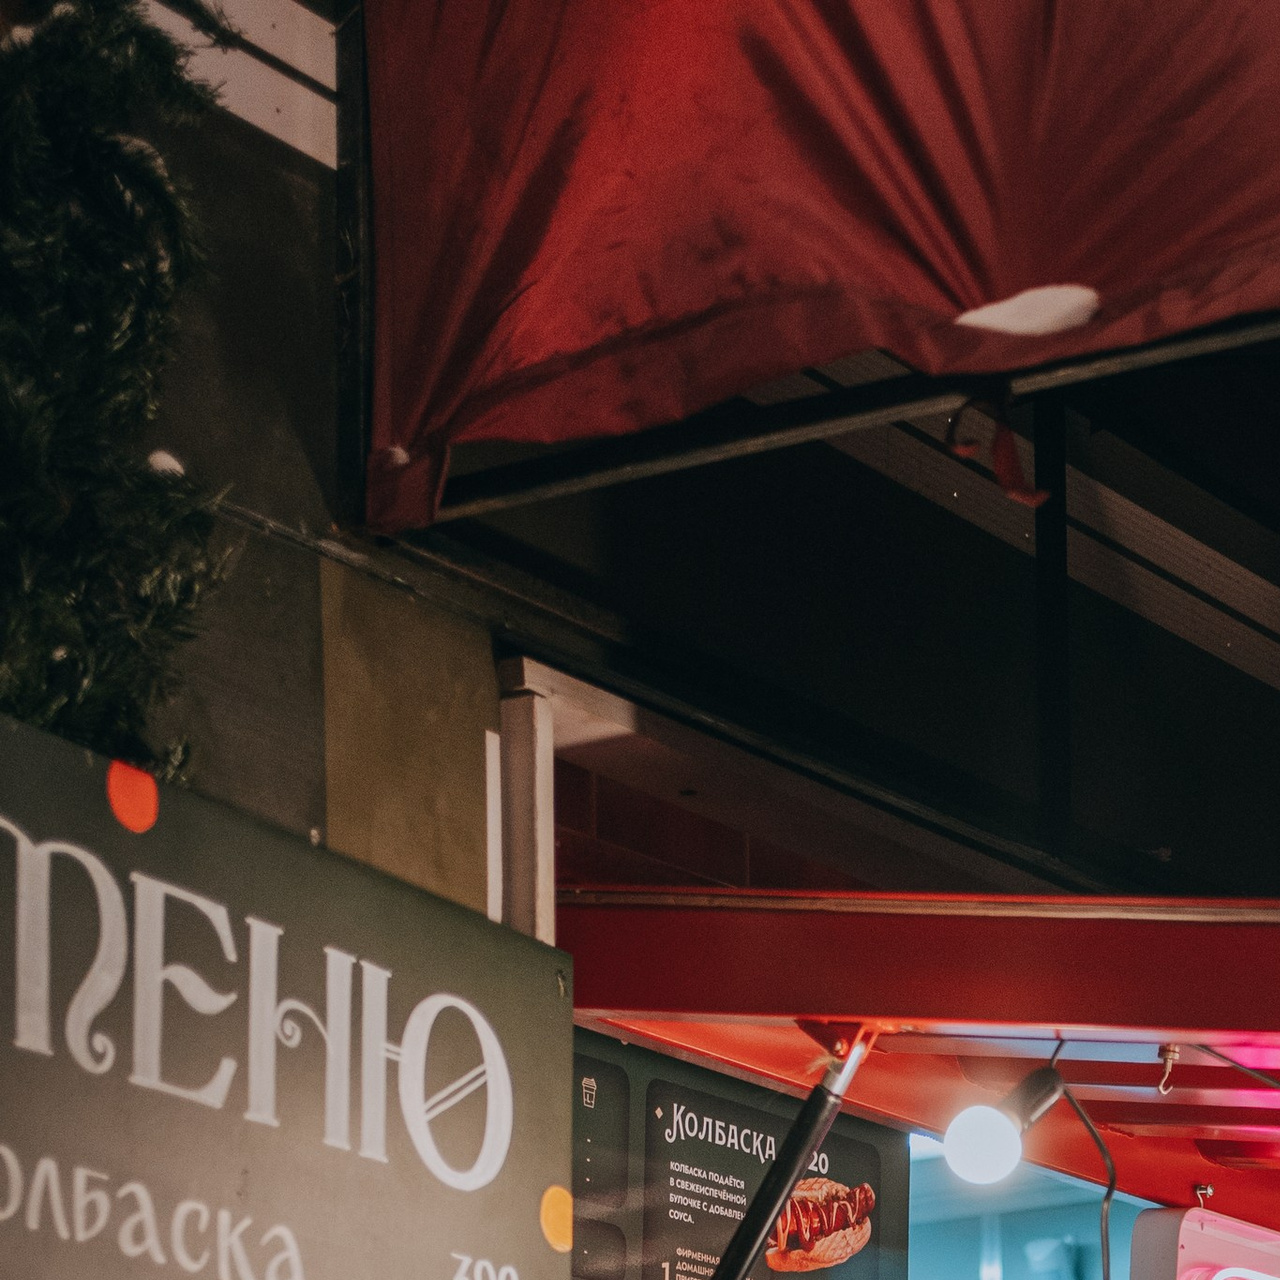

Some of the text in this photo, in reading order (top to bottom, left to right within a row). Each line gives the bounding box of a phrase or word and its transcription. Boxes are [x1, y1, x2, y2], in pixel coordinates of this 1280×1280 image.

[665, 1102, 829, 1175] КОЛБАСКА 20
[670, 1161, 745, 1190] КОЛБАСКА ПОДАЁТСЯ
[670, 1177, 747, 1206] В СВЕЖЕИСПЕЧЁННОЙ
[670, 1194, 701, 1210] БУЛОЧКЕ
[702, 1202, 708, 1212] С
[669, 1209, 695, 1225] СОУСА.
[676, 1247, 720, 1266] ФИРМЕННАЯ
[675, 1261, 714, 1277] ДОМАШНЯ
